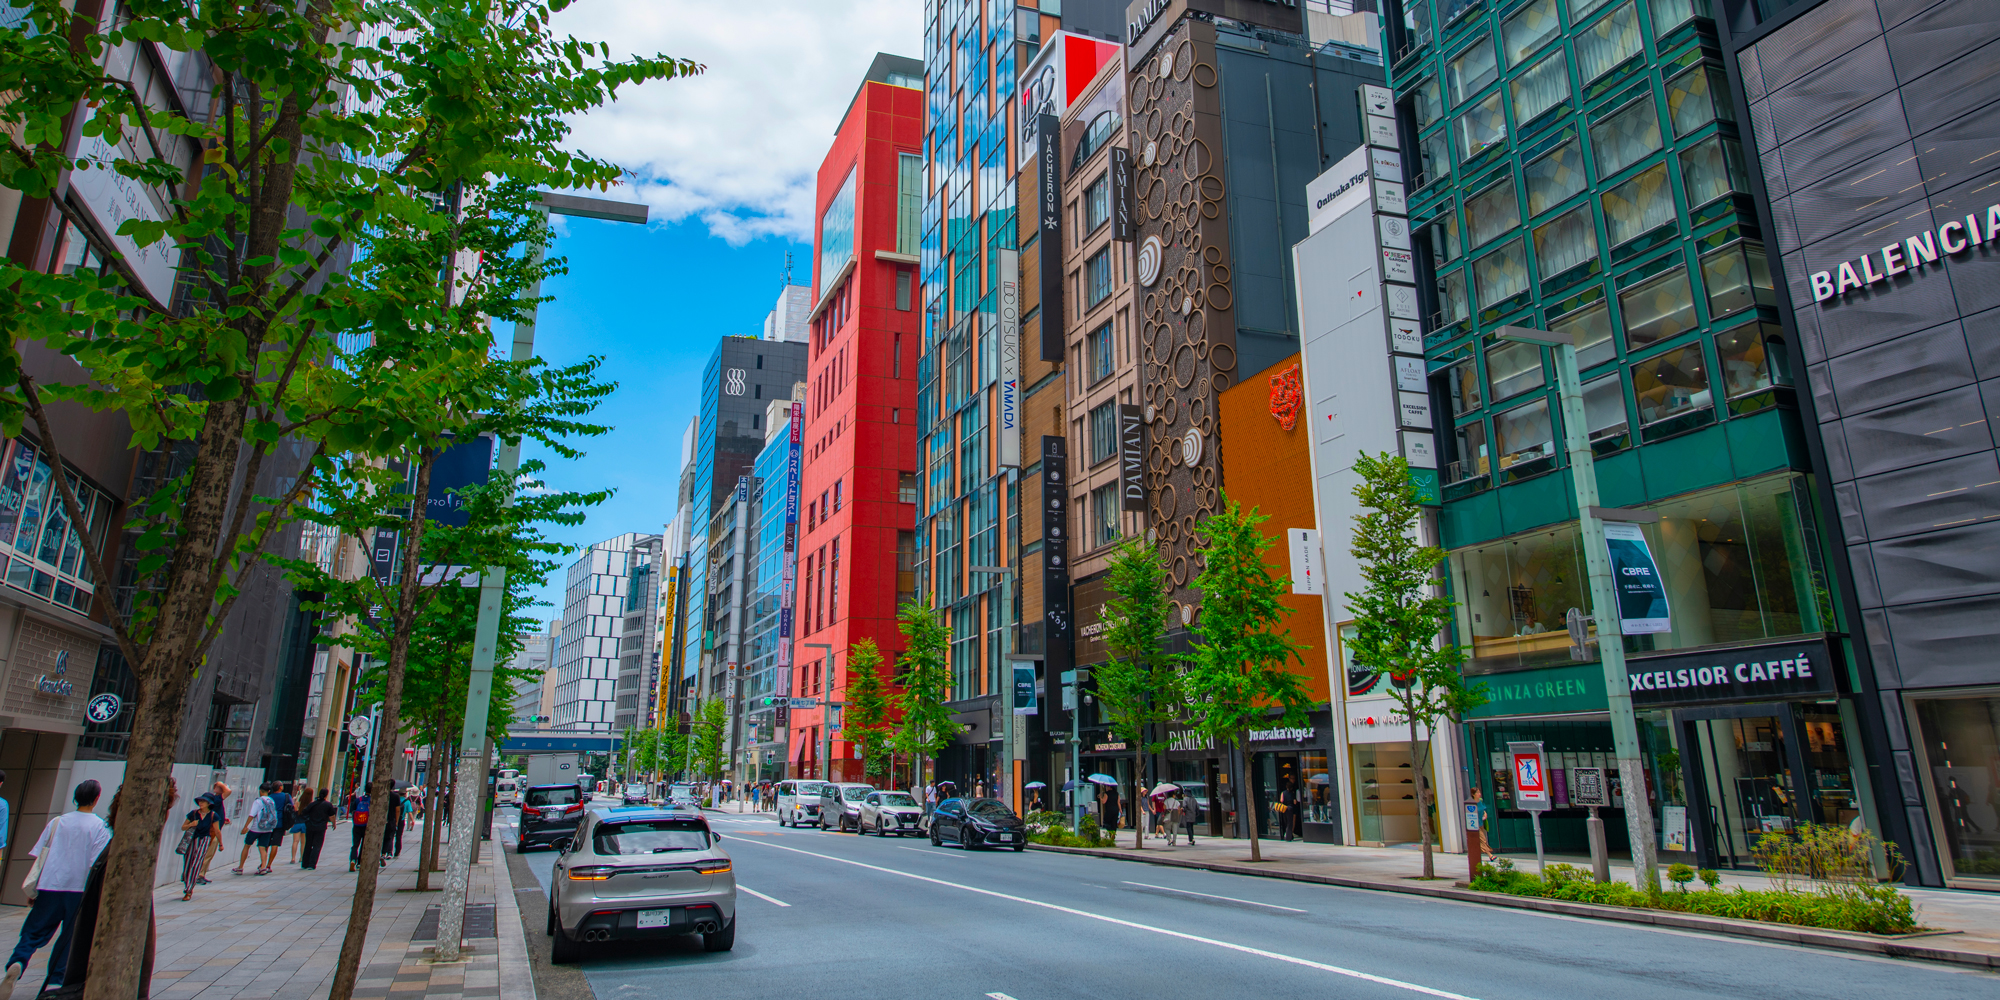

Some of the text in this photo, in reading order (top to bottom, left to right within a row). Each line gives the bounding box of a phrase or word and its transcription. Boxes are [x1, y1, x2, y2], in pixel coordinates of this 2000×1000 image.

[1045, 134, 1055, 213] VACHERON
[1116, 149, 1128, 237] DAMIANI
[1810, 204, 2000, 302] BALENCIA
[1003, 307, 1016, 364] OTSUKA
[1393, 333, 1420, 343] TODOKU
[1004, 378, 1017, 430] YAMADA
[1402, 403, 1428, 411] EXCELSIOR
[1123, 414, 1144, 500] DAMIANI
[1621, 567, 1651, 576] CBRE
[1629, 652, 1813, 691] XCELSIOR CAFFÉ
[1488, 678, 1587, 702] GINZA GREEN
[1381, 714, 1403, 725] MADE
[1168, 730, 1215, 752] DAMIANI
[1470, 819, 1476, 828] 2
